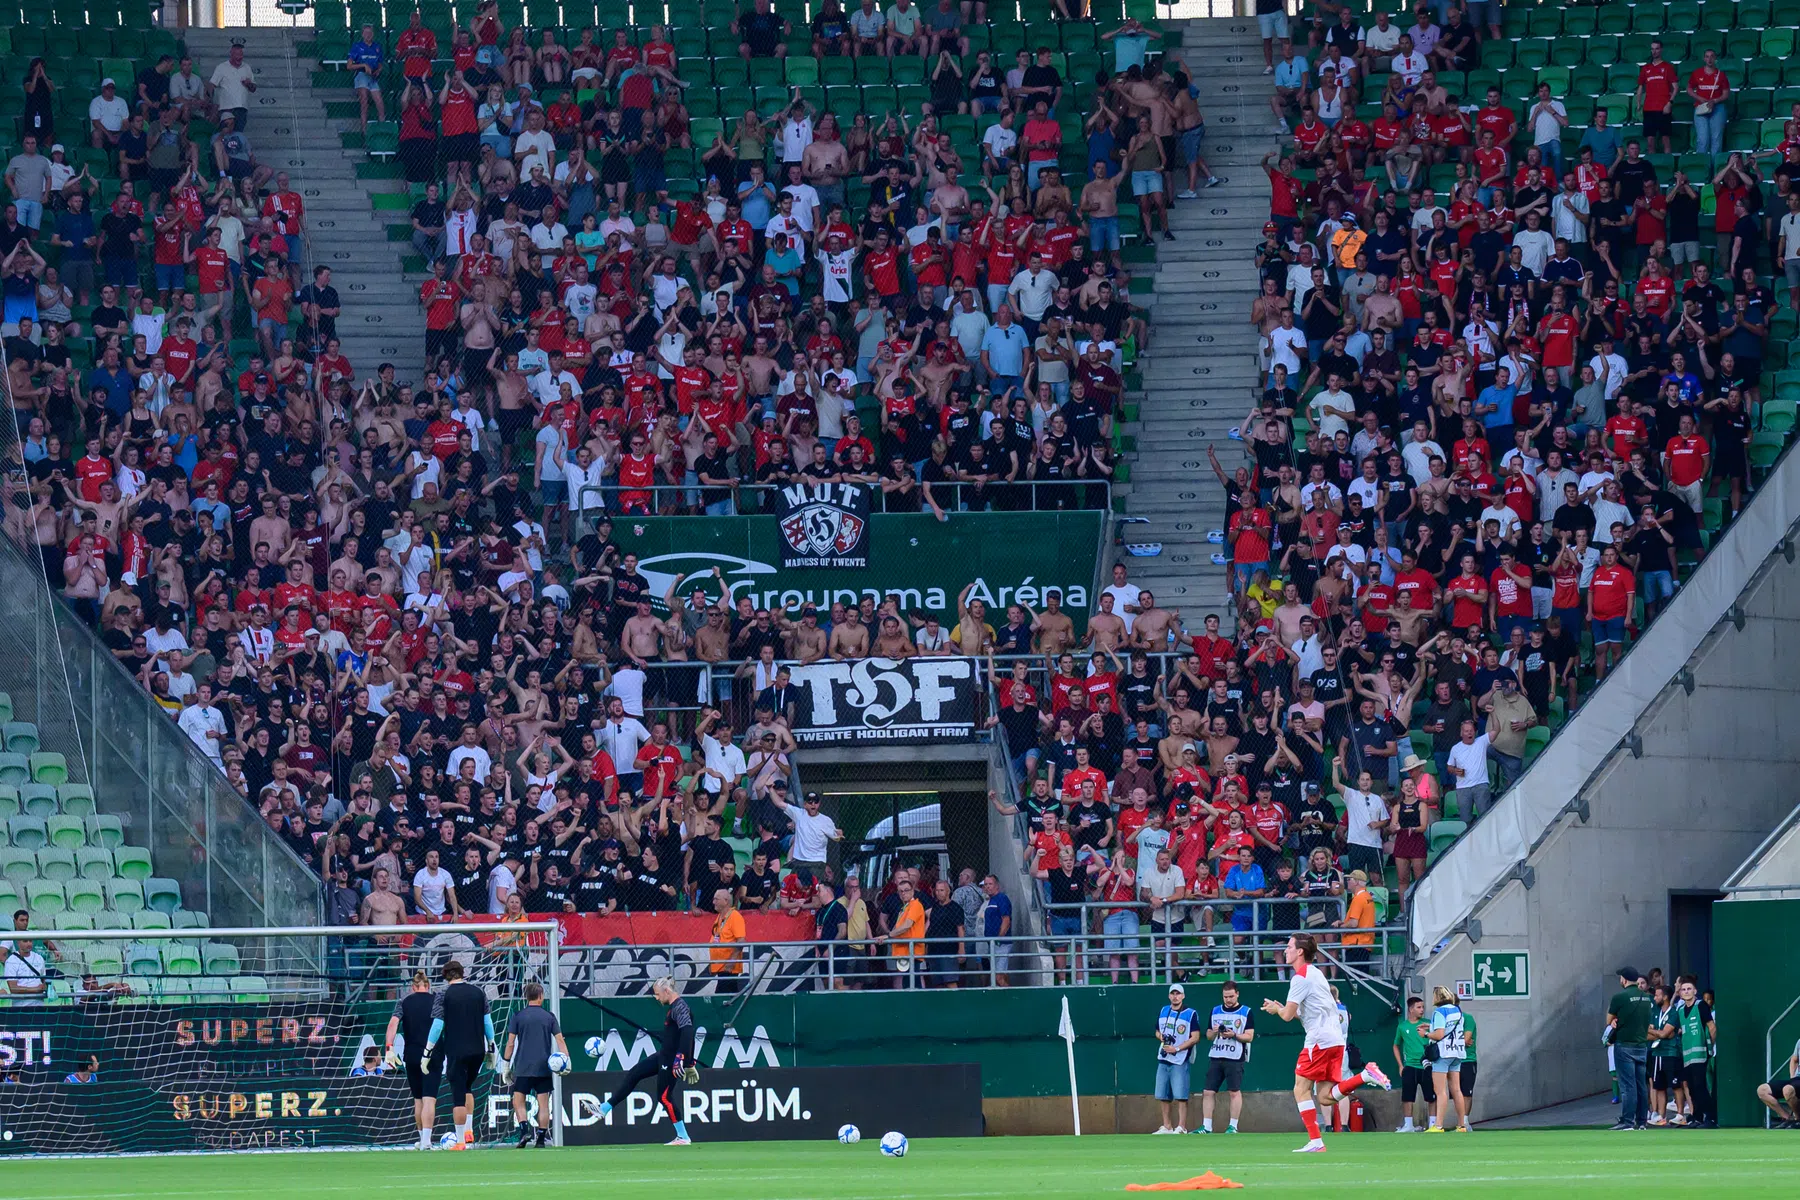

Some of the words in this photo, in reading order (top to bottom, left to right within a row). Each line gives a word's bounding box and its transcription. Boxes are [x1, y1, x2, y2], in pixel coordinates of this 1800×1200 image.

[830, 266, 848, 274] Arke
[820, 558, 830, 566] OF
[833, 558, 865, 567] TWENTE
[965, 577, 1087, 608] Aréna
[795, 731, 852, 743] TWENTE
[856, 728, 928, 739] HOOLIGAN
[933, 727, 969, 737] FIRM
[176, 1017, 340, 1046] SUPERZ.
[173, 1092, 341, 1120] SUPERZ.
